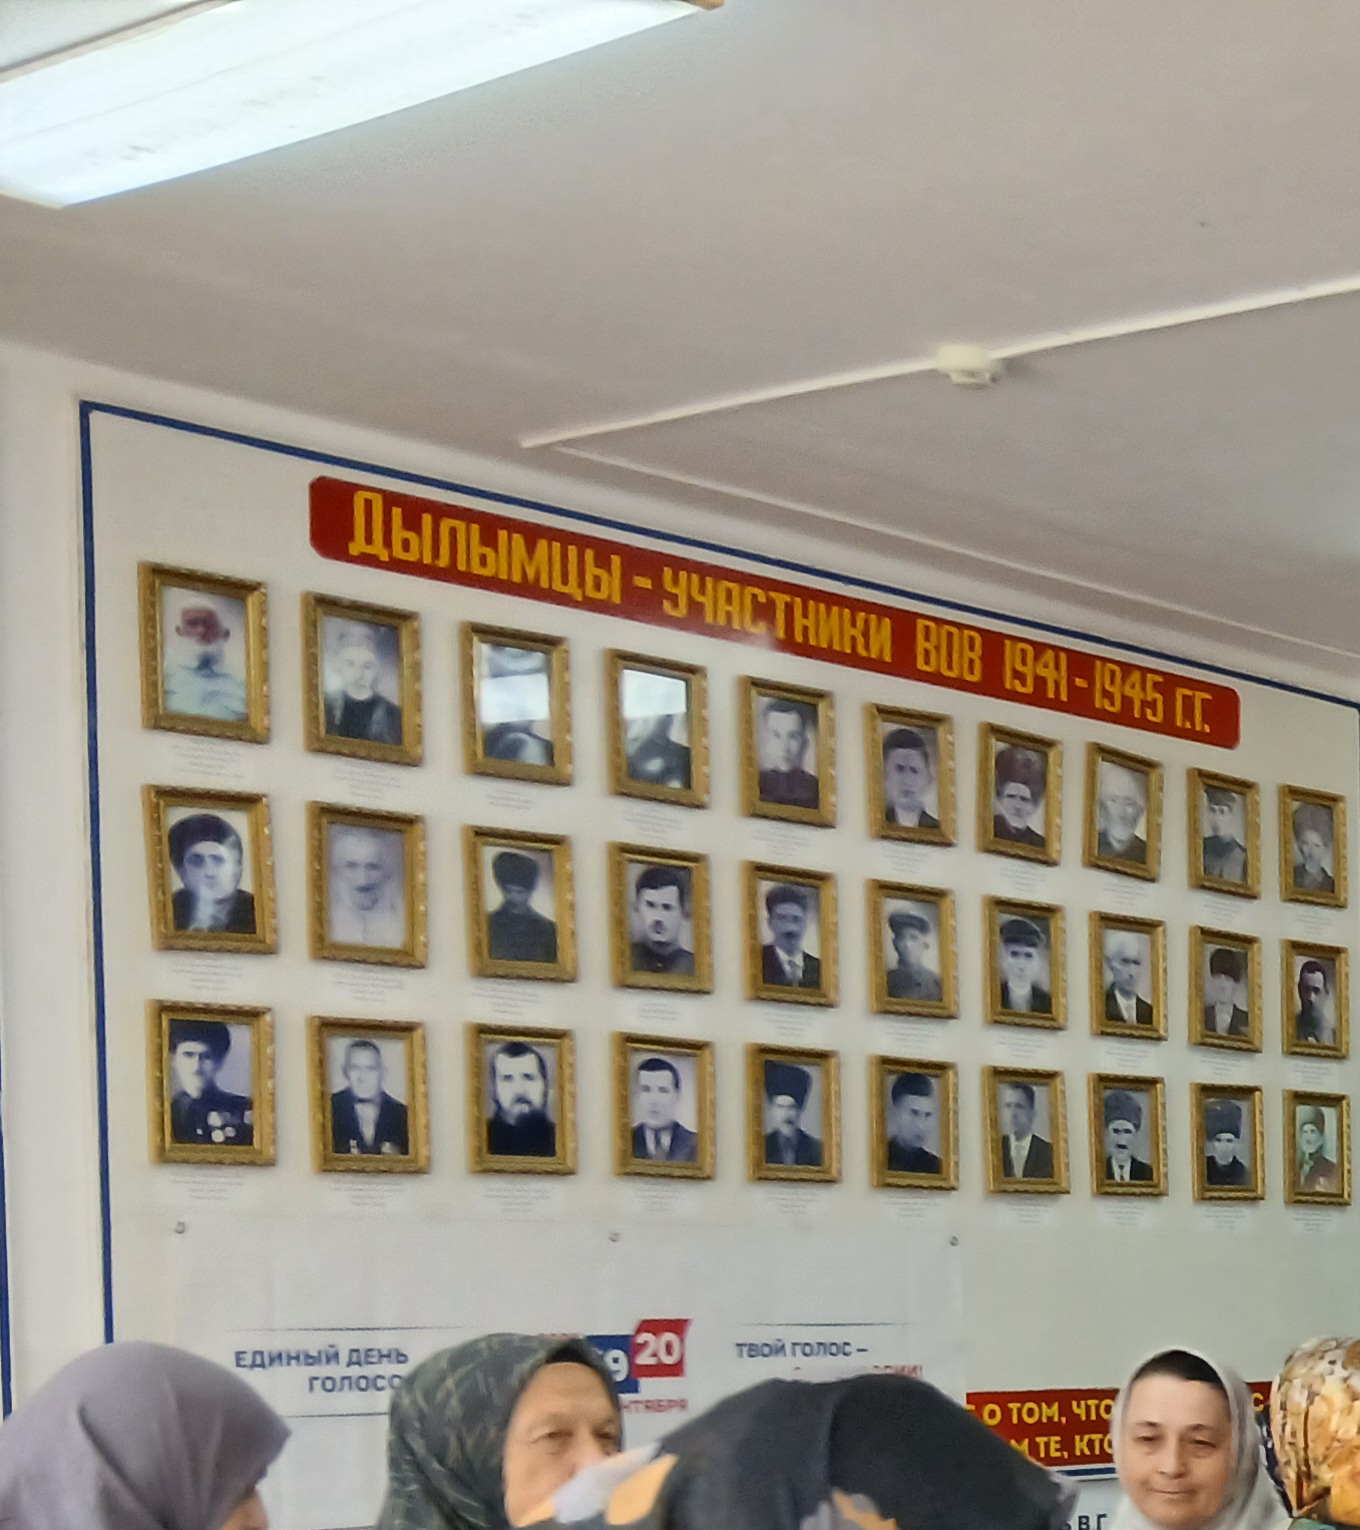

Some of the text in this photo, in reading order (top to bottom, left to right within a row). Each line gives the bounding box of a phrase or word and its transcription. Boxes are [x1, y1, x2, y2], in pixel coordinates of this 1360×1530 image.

[915, 618, 983, 683] ВОВ
[234, 1344, 409, 1369] ЕДИНЫЙ ДЕНЬ
[634, 1332, 681, 1365] 20
[736, 1340, 788, 1358] ТВОЙ
[791, 1341, 852, 1357] ГОЛОС
[308, 1374, 405, 1393] ГОЛОСО
[982, 1403, 1002, 1426] О
